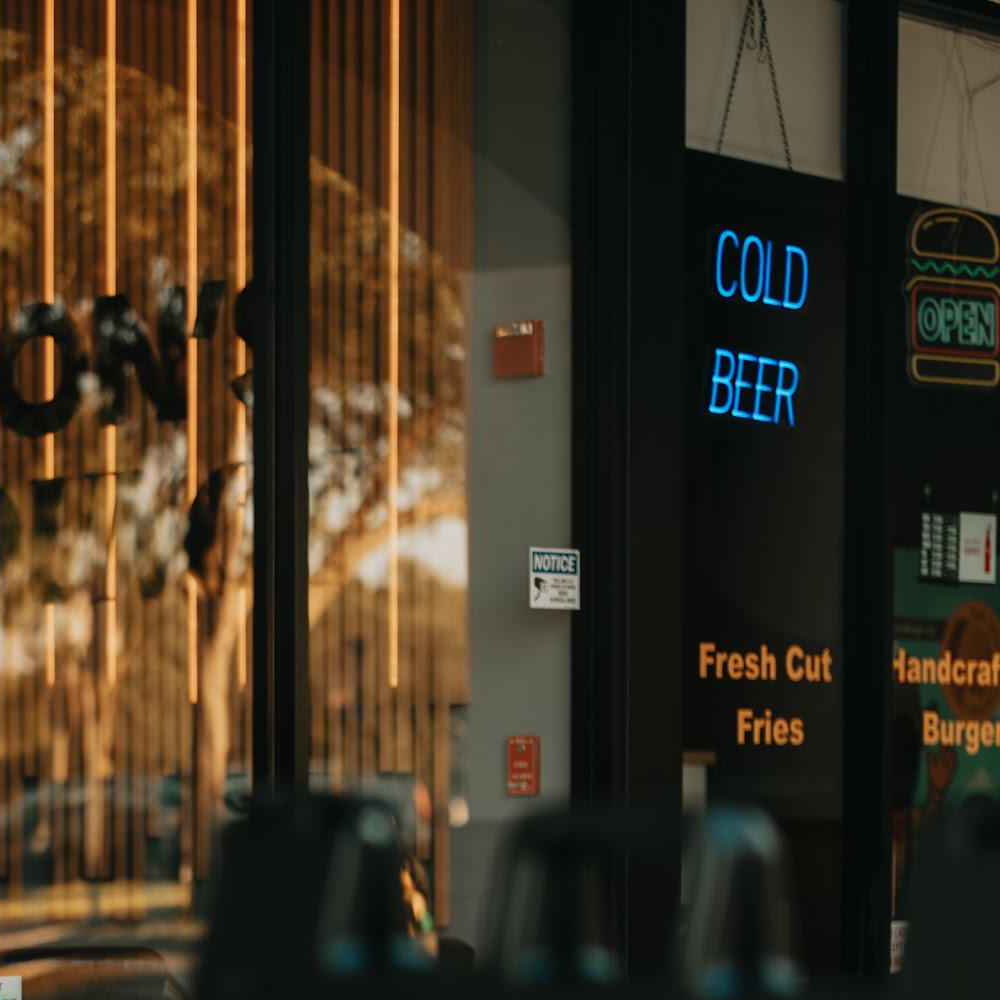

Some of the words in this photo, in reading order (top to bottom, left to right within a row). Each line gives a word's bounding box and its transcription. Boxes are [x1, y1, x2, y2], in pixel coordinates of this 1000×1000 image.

[715, 230, 809, 310] COLD
[917, 297, 996, 347] OPEN
[709, 347, 800, 427] BEER
[534, 553, 576, 573] NOTICE
[699, 642, 777, 681] Fresh
[785, 644, 833, 682] Cut
[736, 708, 805, 746] Fries
